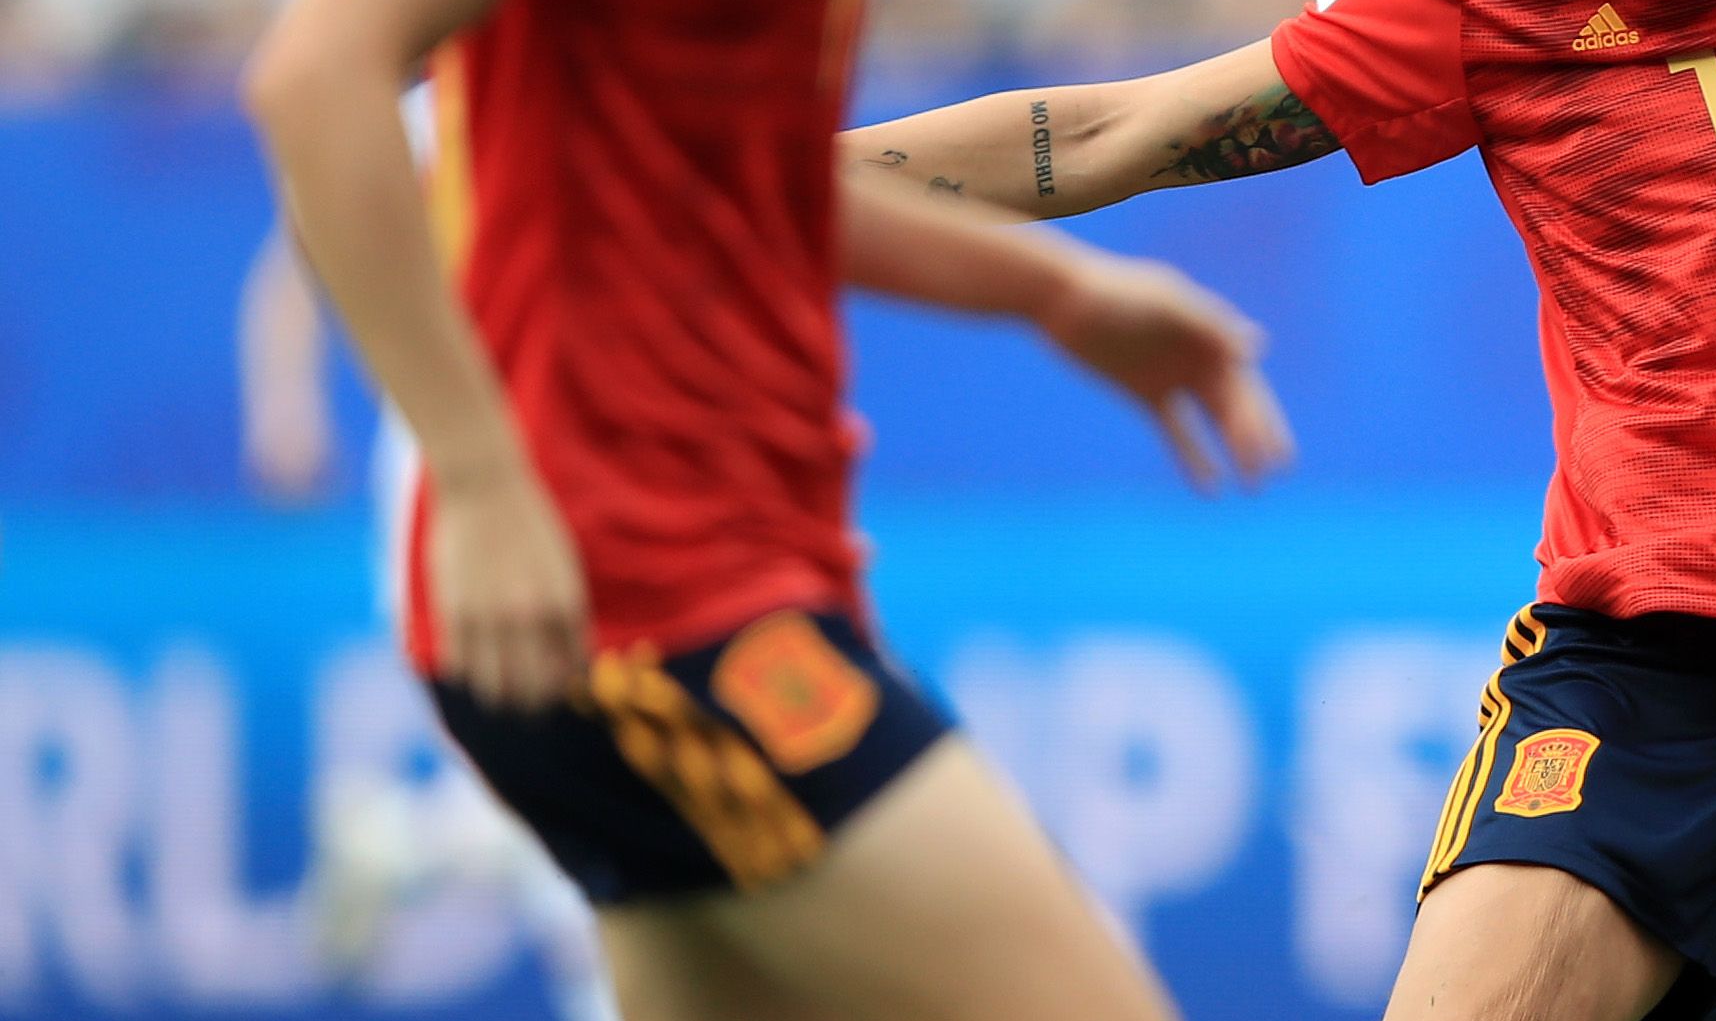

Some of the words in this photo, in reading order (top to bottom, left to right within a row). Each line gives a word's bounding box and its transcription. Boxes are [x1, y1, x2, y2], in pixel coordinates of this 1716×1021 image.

[1571, 30, 1640, 52] adidas
[1030, 100, 1049, 125] MO
[1033, 129, 1054, 197] CUISHLE
